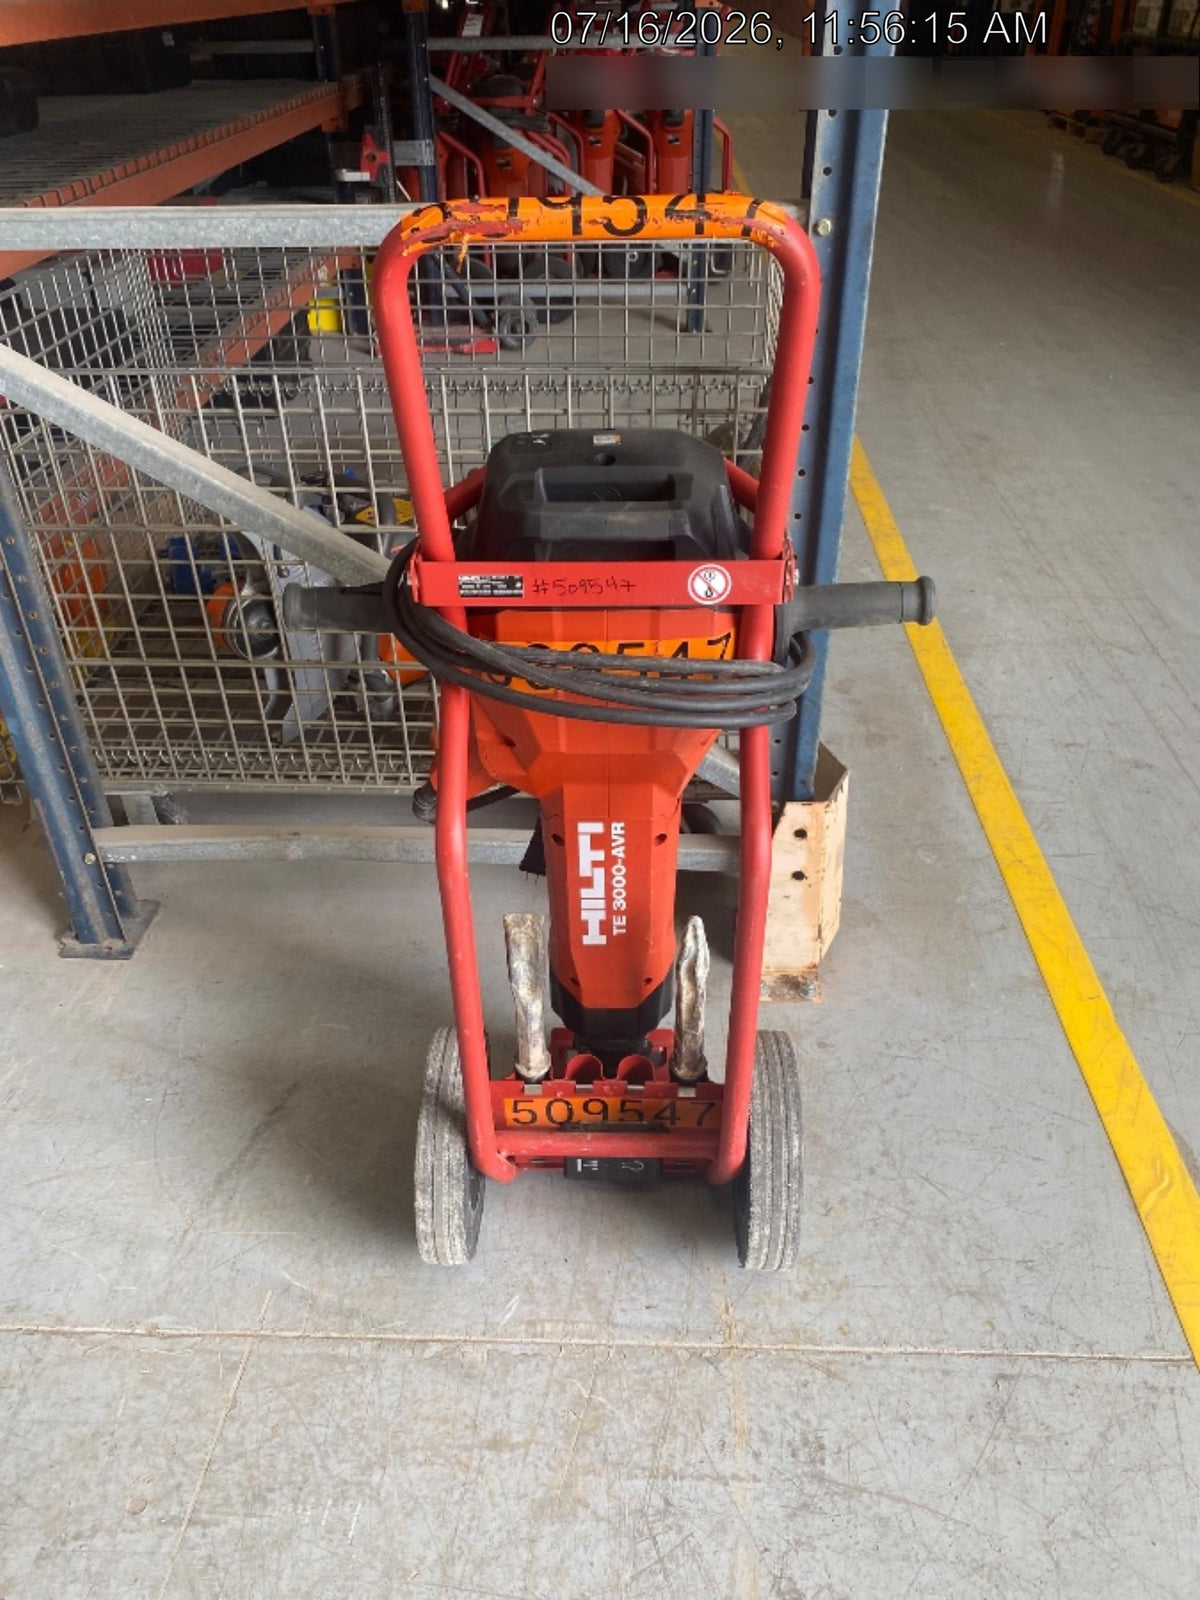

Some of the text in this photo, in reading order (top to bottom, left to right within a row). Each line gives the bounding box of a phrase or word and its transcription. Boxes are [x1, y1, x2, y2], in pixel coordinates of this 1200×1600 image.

[532, 576, 637, 596] #509547
[577, 821, 607, 945] HILTI
[611, 821, 627, 936] TE 3000-AVR
[511, 1098, 716, 1126] 509547
